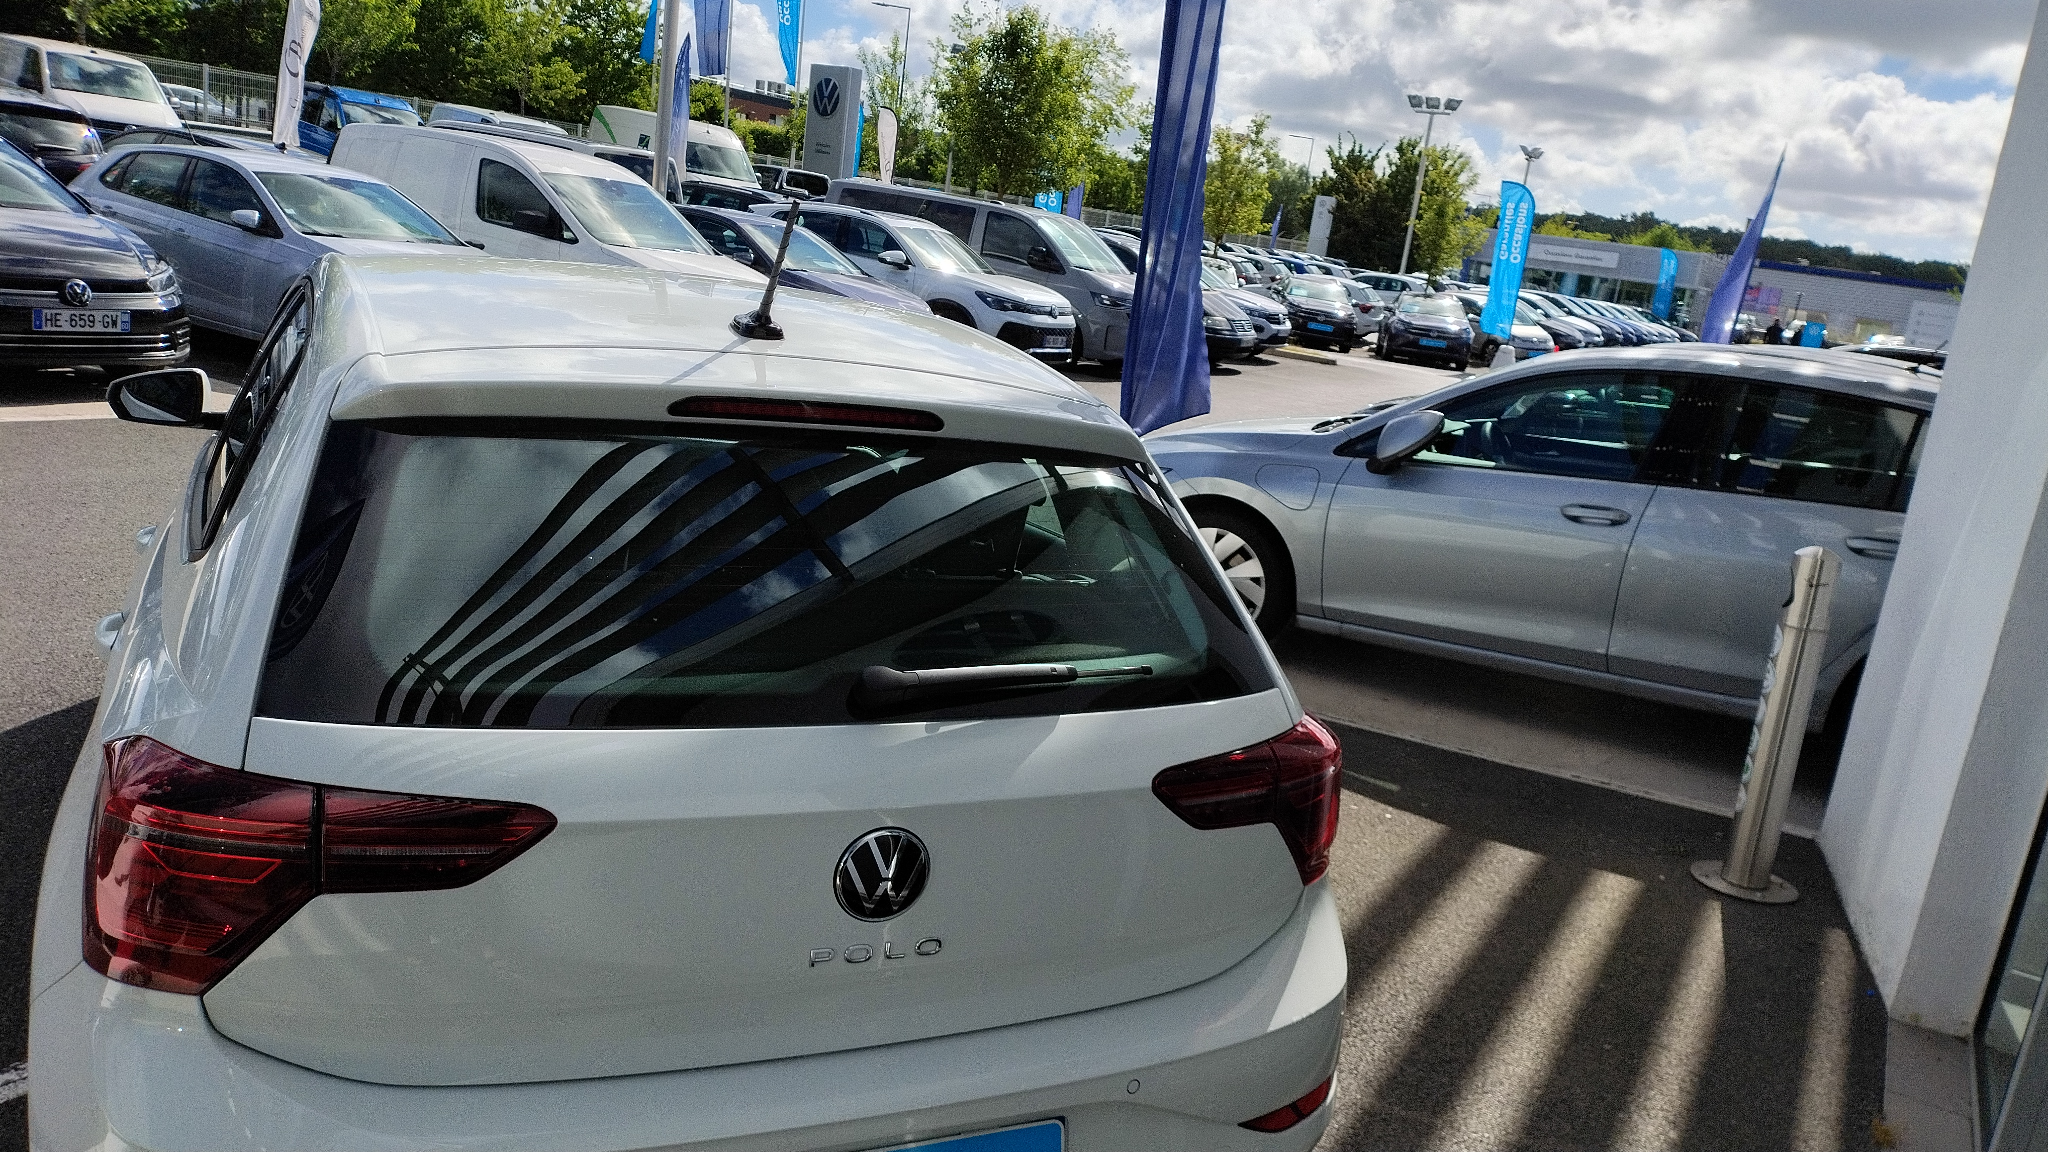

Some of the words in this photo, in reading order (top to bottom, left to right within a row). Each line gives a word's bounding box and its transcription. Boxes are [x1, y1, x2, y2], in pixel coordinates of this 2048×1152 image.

[44, 313, 119, 329] HE-659-GW
[121, 322, 129, 330] 60
[809, 937, 942, 967] POLO
